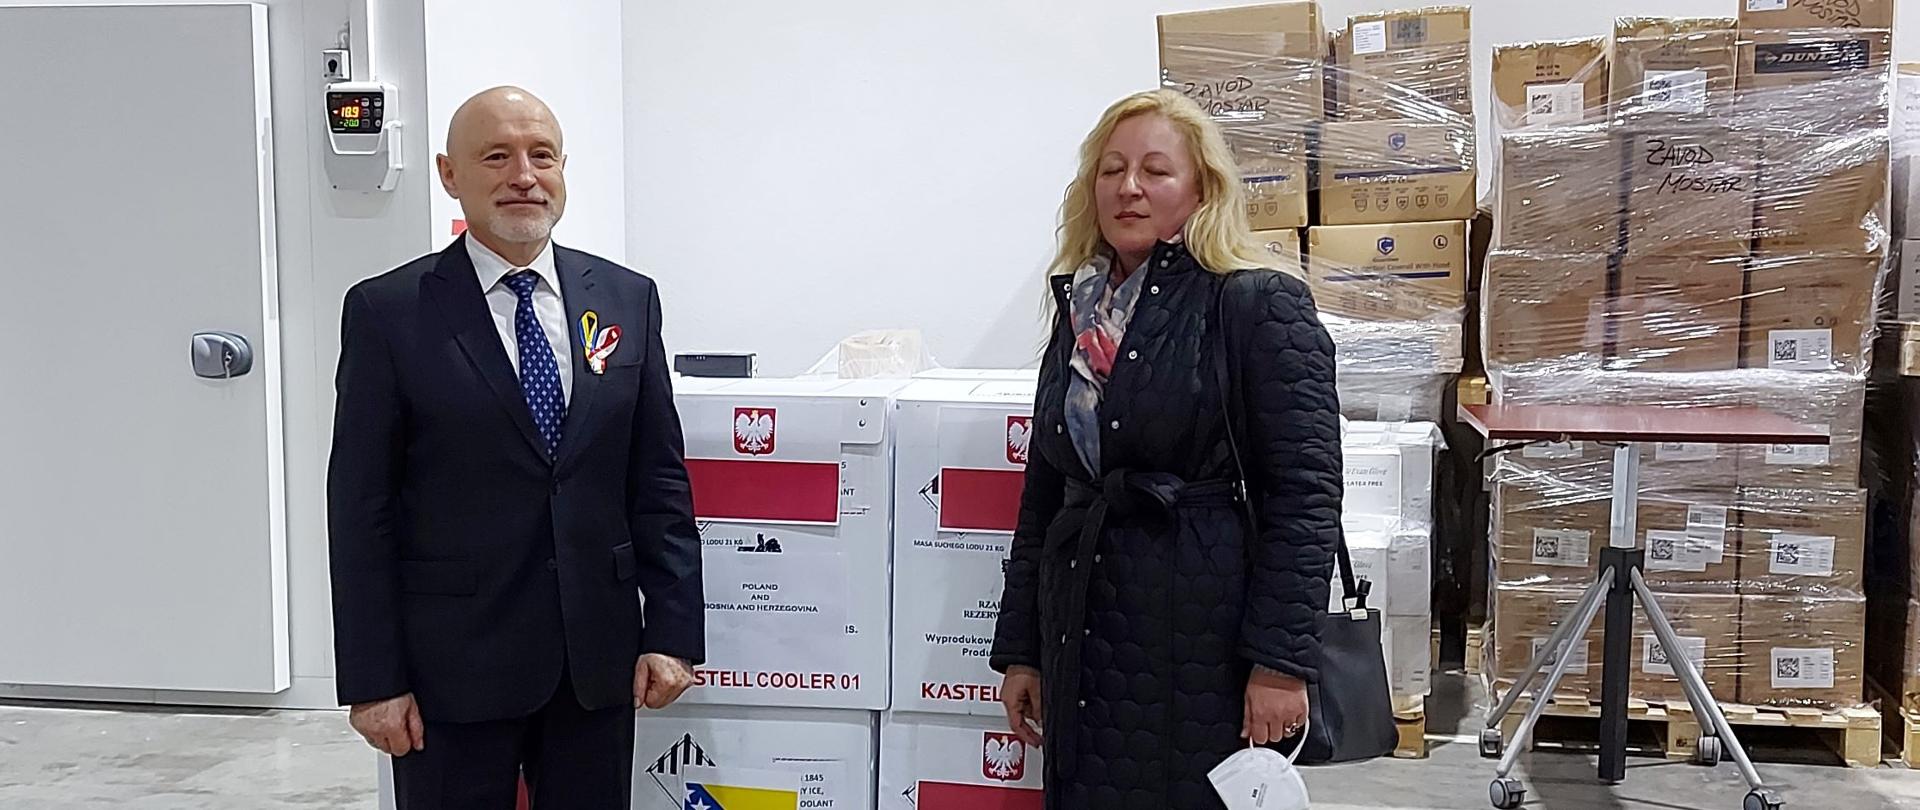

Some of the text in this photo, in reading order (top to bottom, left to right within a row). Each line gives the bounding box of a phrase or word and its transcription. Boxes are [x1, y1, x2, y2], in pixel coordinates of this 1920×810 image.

[1779, 49, 1862, 63] DUNL
[1183, 77, 1253, 98] ZAVOD
[1646, 139, 1713, 167] ZAVOD
[1657, 172, 1746, 195] MOSTAR
[934, 541, 964, 549] SUCHEGO
[742, 583, 778, 591] POLAND
[756, 605, 818, 613] HERZEGOVINA
[925, 633, 993, 645] Wyprodukow
[694, 670, 860, 690] STELL COOLER 01
[805, 774, 824, 782] 1845
[809, 787, 824, 795] ICE,
